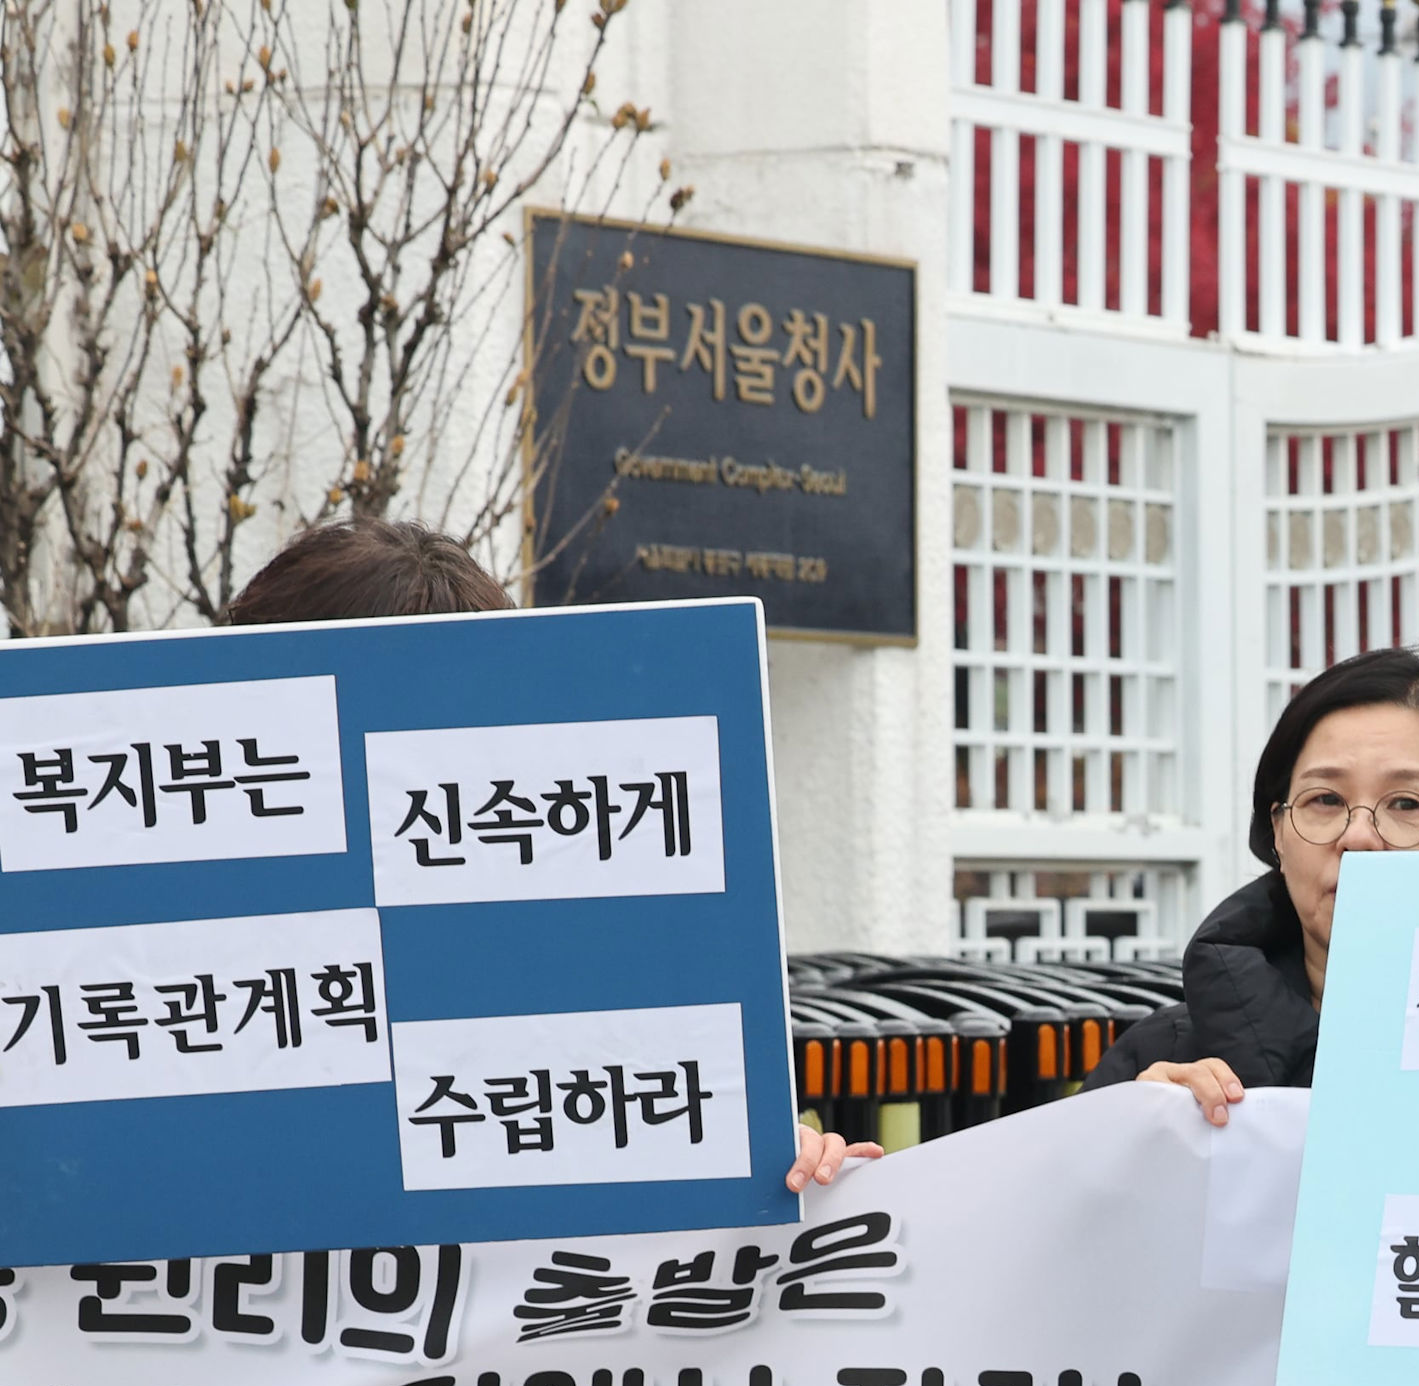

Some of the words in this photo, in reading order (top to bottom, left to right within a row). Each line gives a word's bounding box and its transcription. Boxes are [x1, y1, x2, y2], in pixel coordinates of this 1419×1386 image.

[570, 285, 882, 420] 정부서울청사
[13, 739, 310, 833] 복지부는
[395, 772, 691, 866] 신속하게
[2, 963, 377, 1065] 기록관계획
[409, 1061, 712, 1158] 수립하라
[513, 1211, 897, 1343] 출발은
